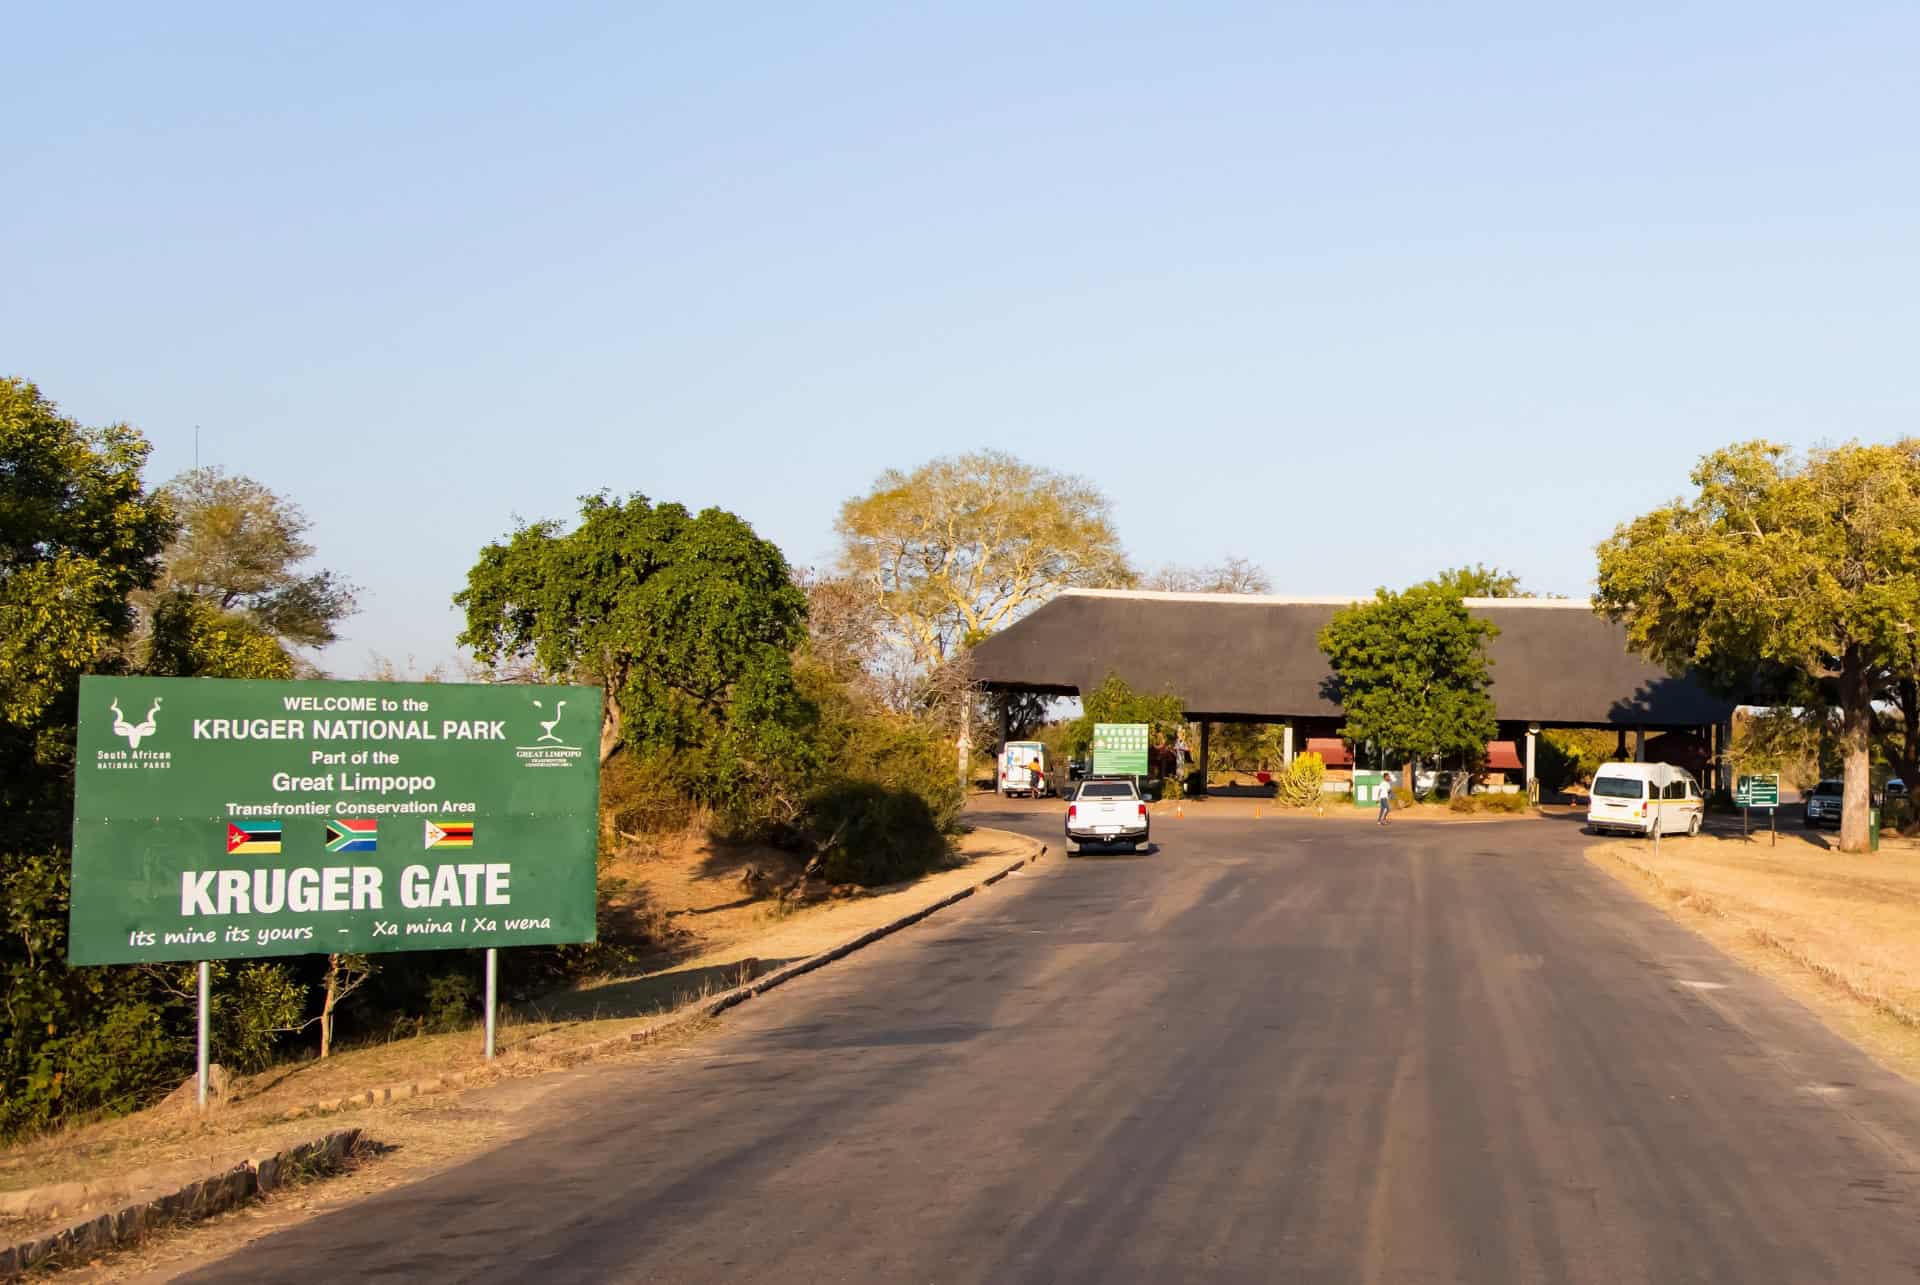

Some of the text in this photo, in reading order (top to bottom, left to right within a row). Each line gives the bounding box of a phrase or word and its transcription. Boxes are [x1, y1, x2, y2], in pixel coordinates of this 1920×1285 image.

[284, 696, 429, 712] WELCOME to the
[193, 718, 506, 740] KRUGER NATIONAL PARK
[97, 750, 171, 760] South African
[311, 750, 400, 765] Part of the
[271, 772, 436, 795] Great Limpopo
[225, 800, 476, 816] Transfrontier Conservation Area
[180, 863, 511, 917] KRUGER GATE
[129, 930, 156, 947] Its
[164, 927, 217, 945] mine
[224, 925, 250, 943] its
[256, 926, 313, 946] yours
[372, 920, 399, 937] Xa
[405, 918, 453, 935] mina
[472, 917, 497, 933] Xa
[504, 917, 551, 931] wena
